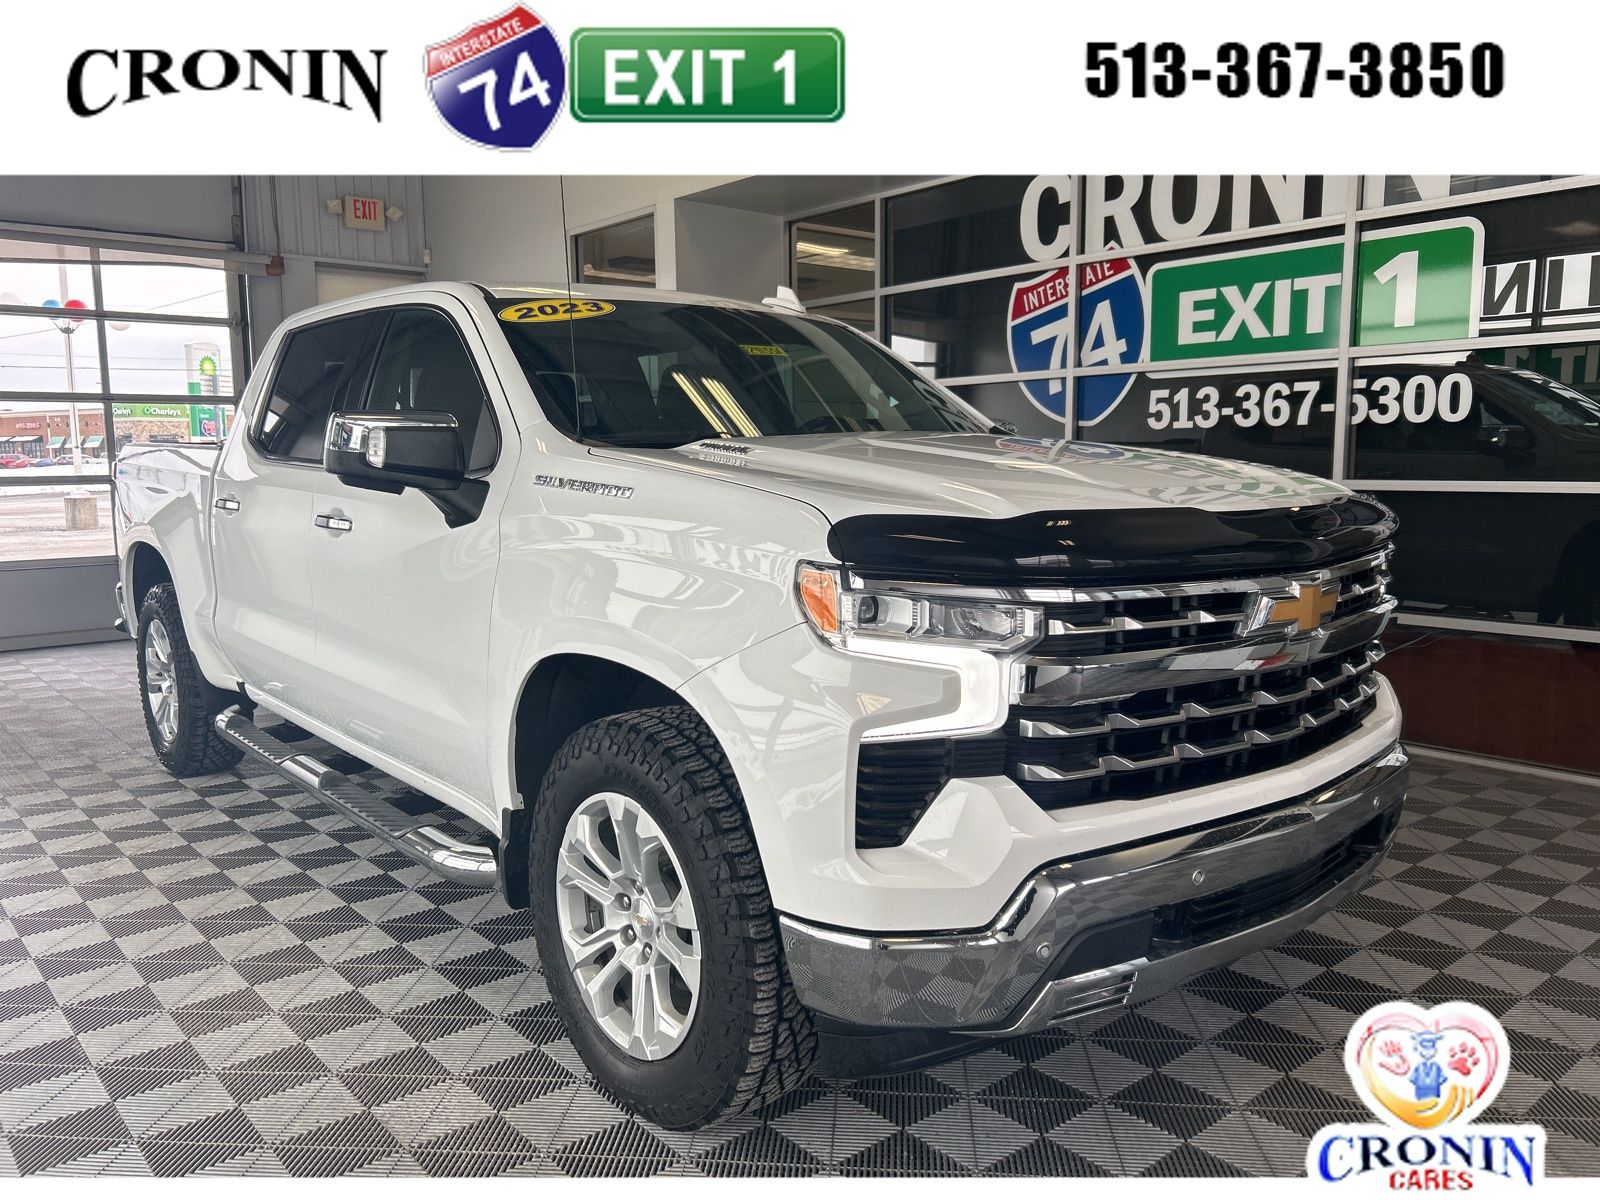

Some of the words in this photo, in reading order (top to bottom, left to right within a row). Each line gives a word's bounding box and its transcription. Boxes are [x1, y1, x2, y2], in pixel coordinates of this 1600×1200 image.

[353, 198, 379, 222] EXIT
[514, 301, 605, 320] 2023
[1023, 262, 1115, 312] INTERATE
[1178, 272, 1342, 346] EXIT
[1373, 250, 1419, 328] 1
[1030, 299, 1128, 396] 74
[1146, 372, 1473, 430] 513-367-5300
